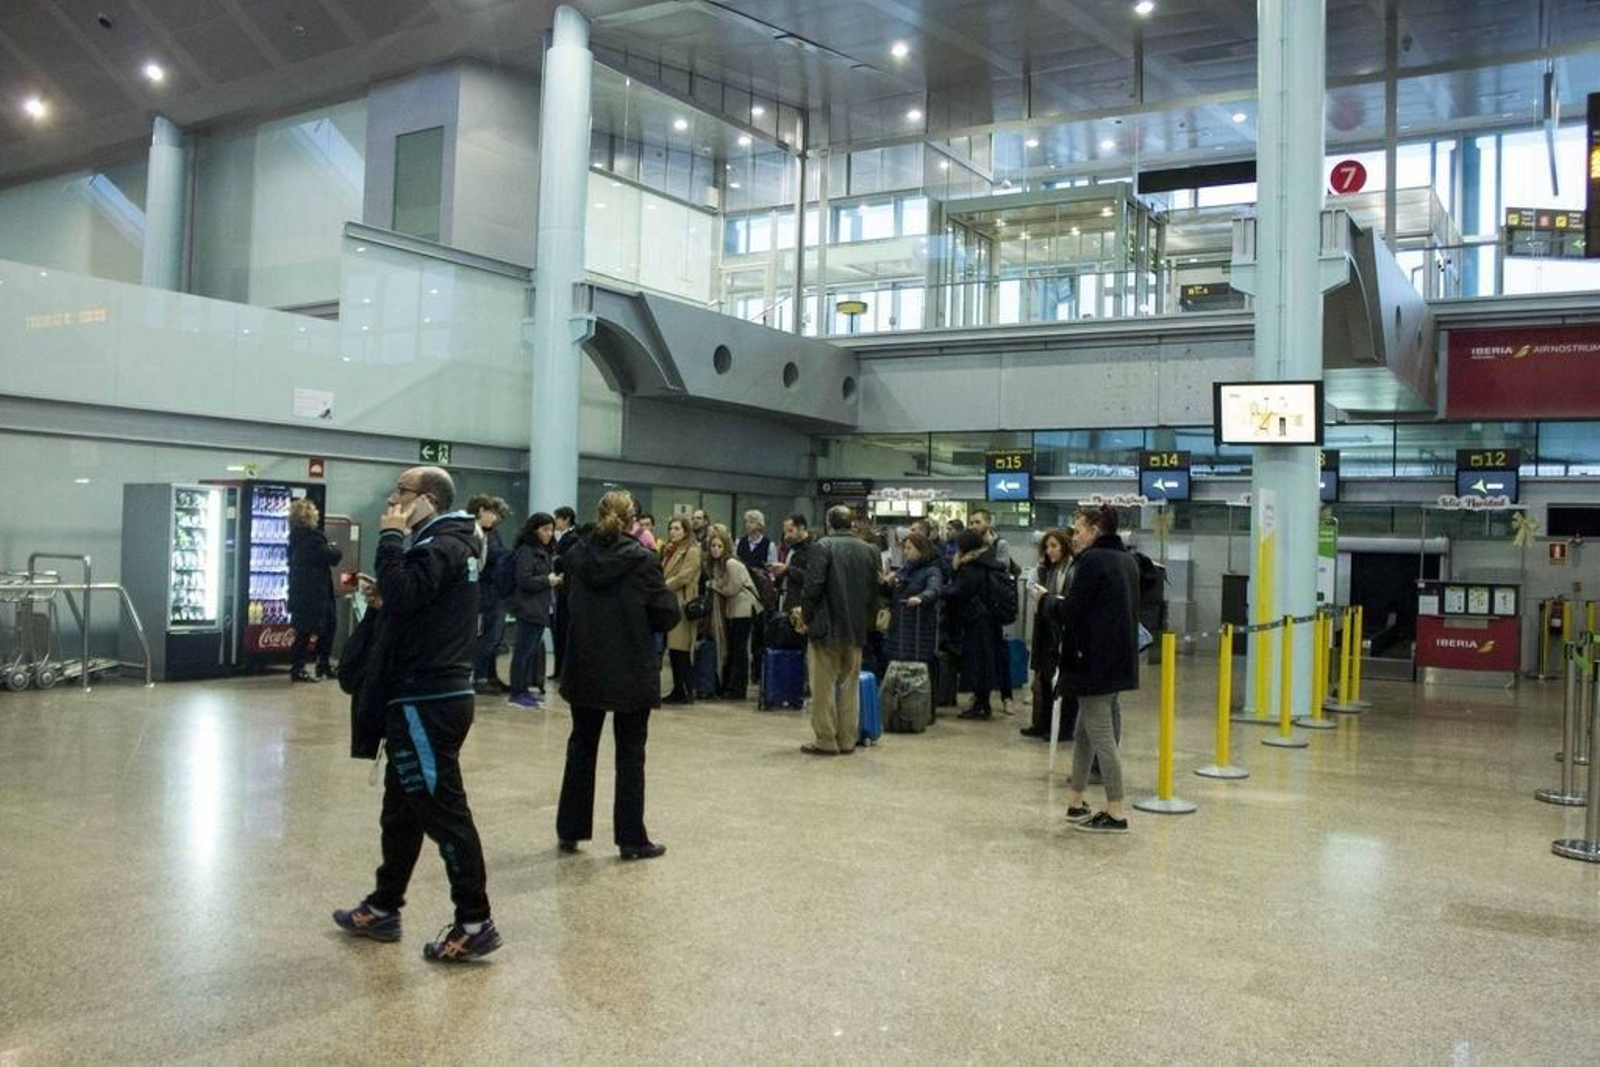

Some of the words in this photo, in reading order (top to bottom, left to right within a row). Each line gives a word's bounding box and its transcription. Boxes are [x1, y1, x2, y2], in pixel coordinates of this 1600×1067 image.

[1341, 166, 1357, 189] 7
[1471, 346, 1513, 355] IBERIA
[1006, 455, 1022, 470] 15
[1160, 453, 1179, 467] 14
[1485, 451, 1506, 467] 12
[1436, 637, 1478, 649] IBERIA
